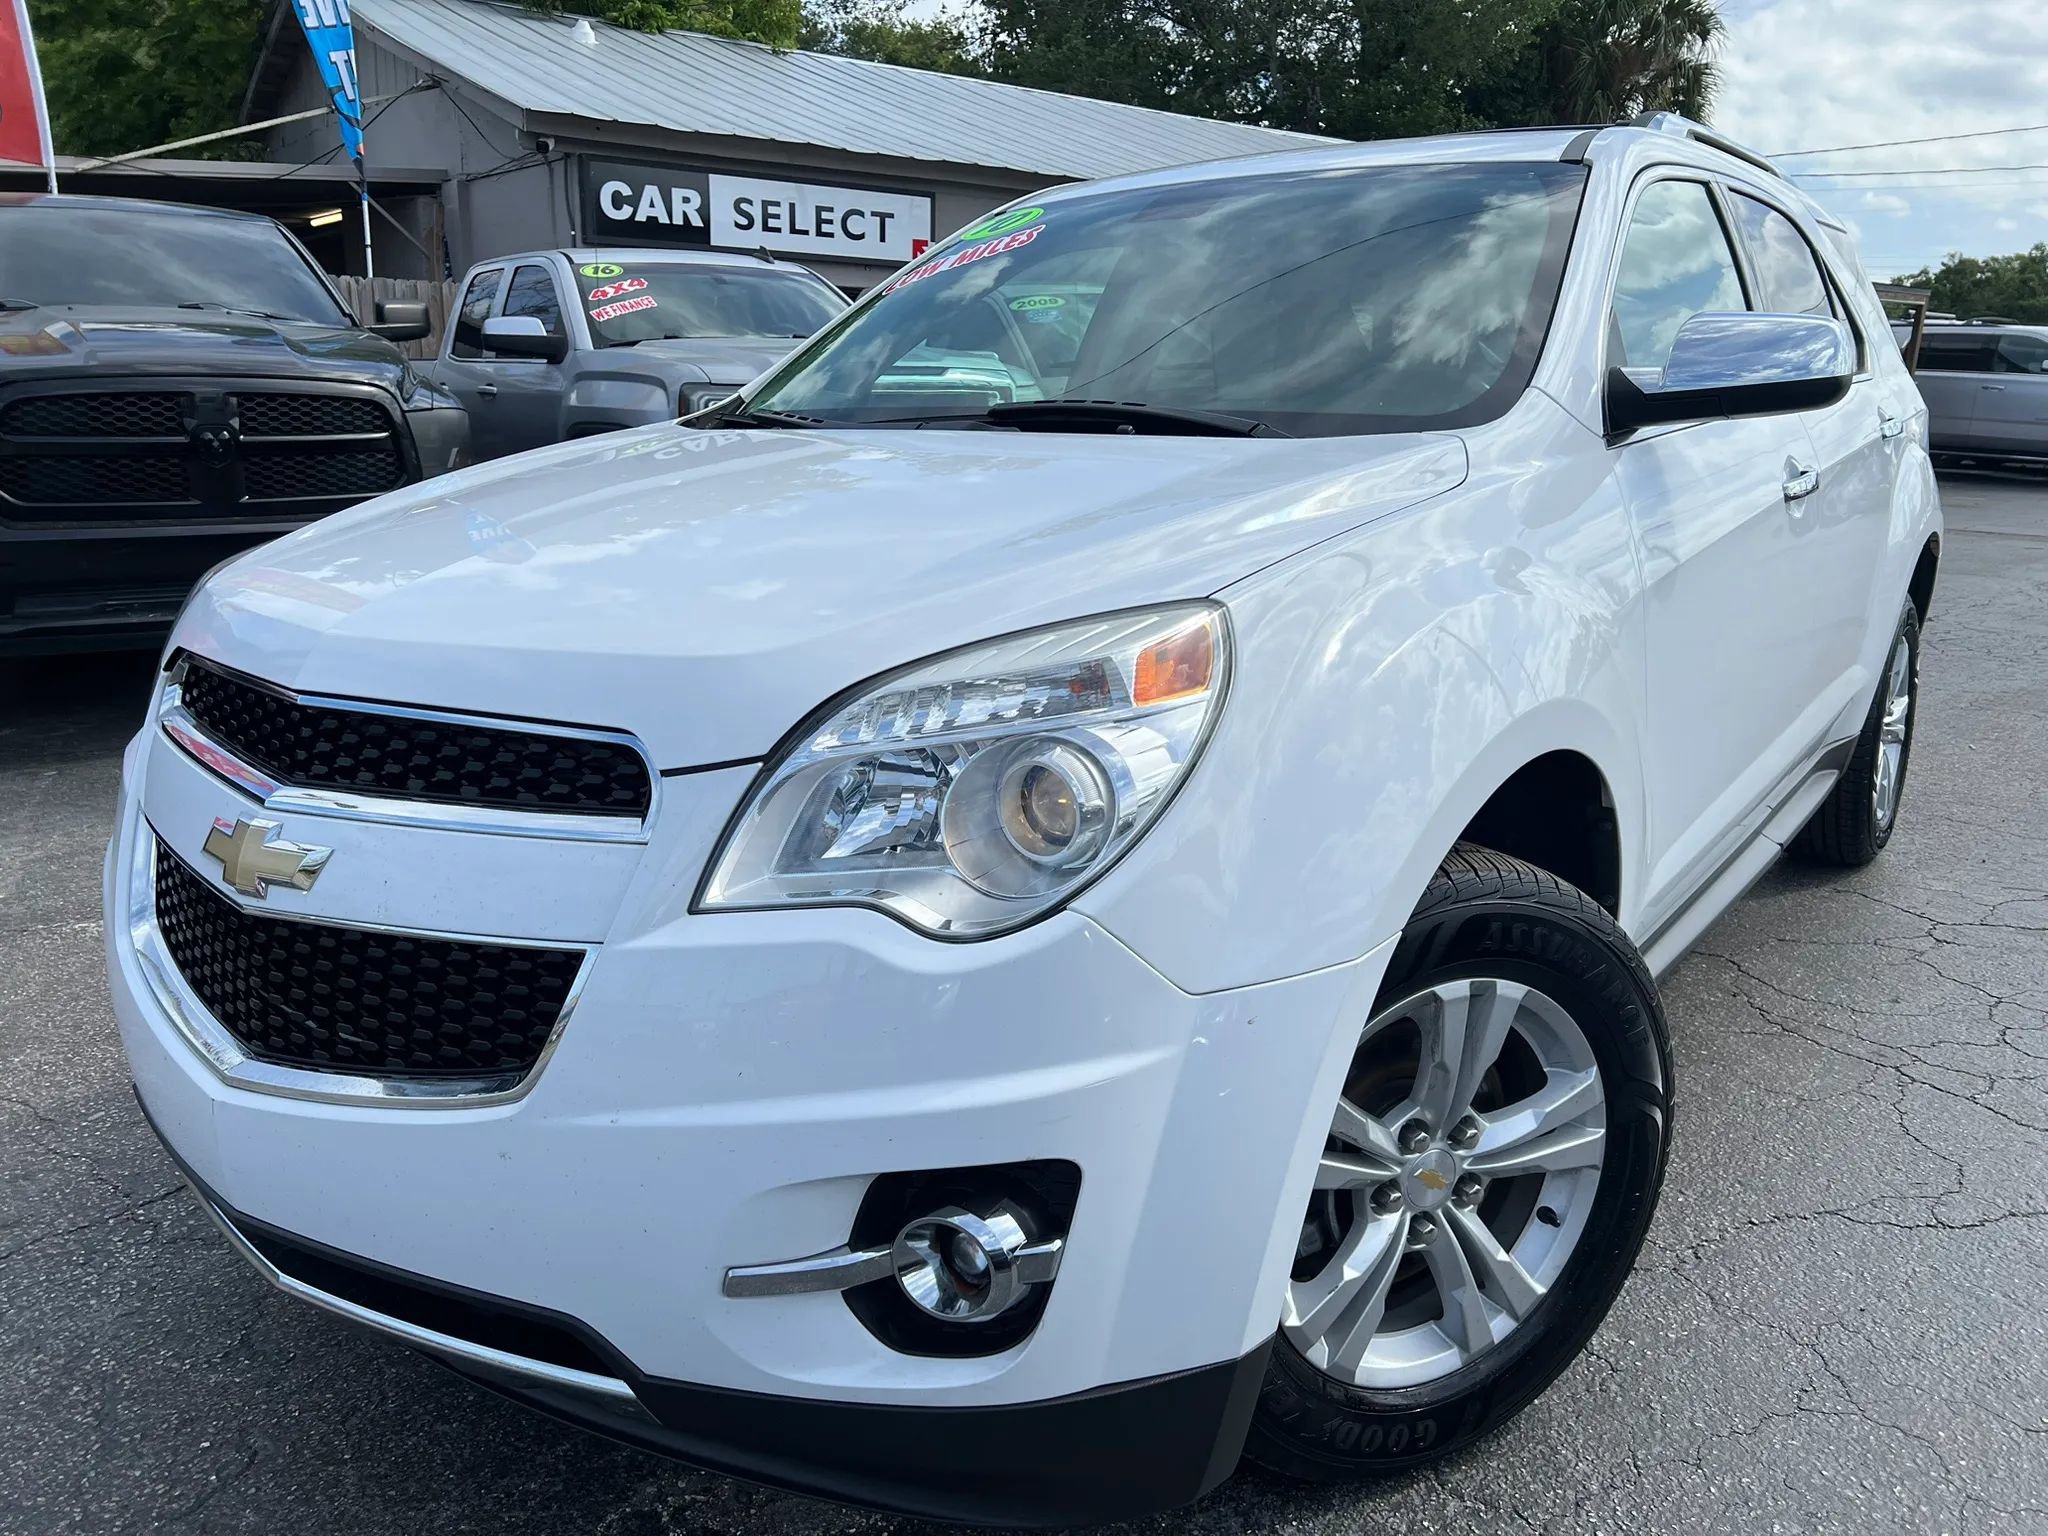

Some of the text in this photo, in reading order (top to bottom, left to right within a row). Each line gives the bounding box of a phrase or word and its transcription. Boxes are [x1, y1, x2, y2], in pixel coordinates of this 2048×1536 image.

[600, 180, 895, 243] CAR SELECT
[591, 265, 615, 275] 16
[883, 225, 1044, 295] LOW MILES
[592, 297, 656, 321] WE FINANCE
